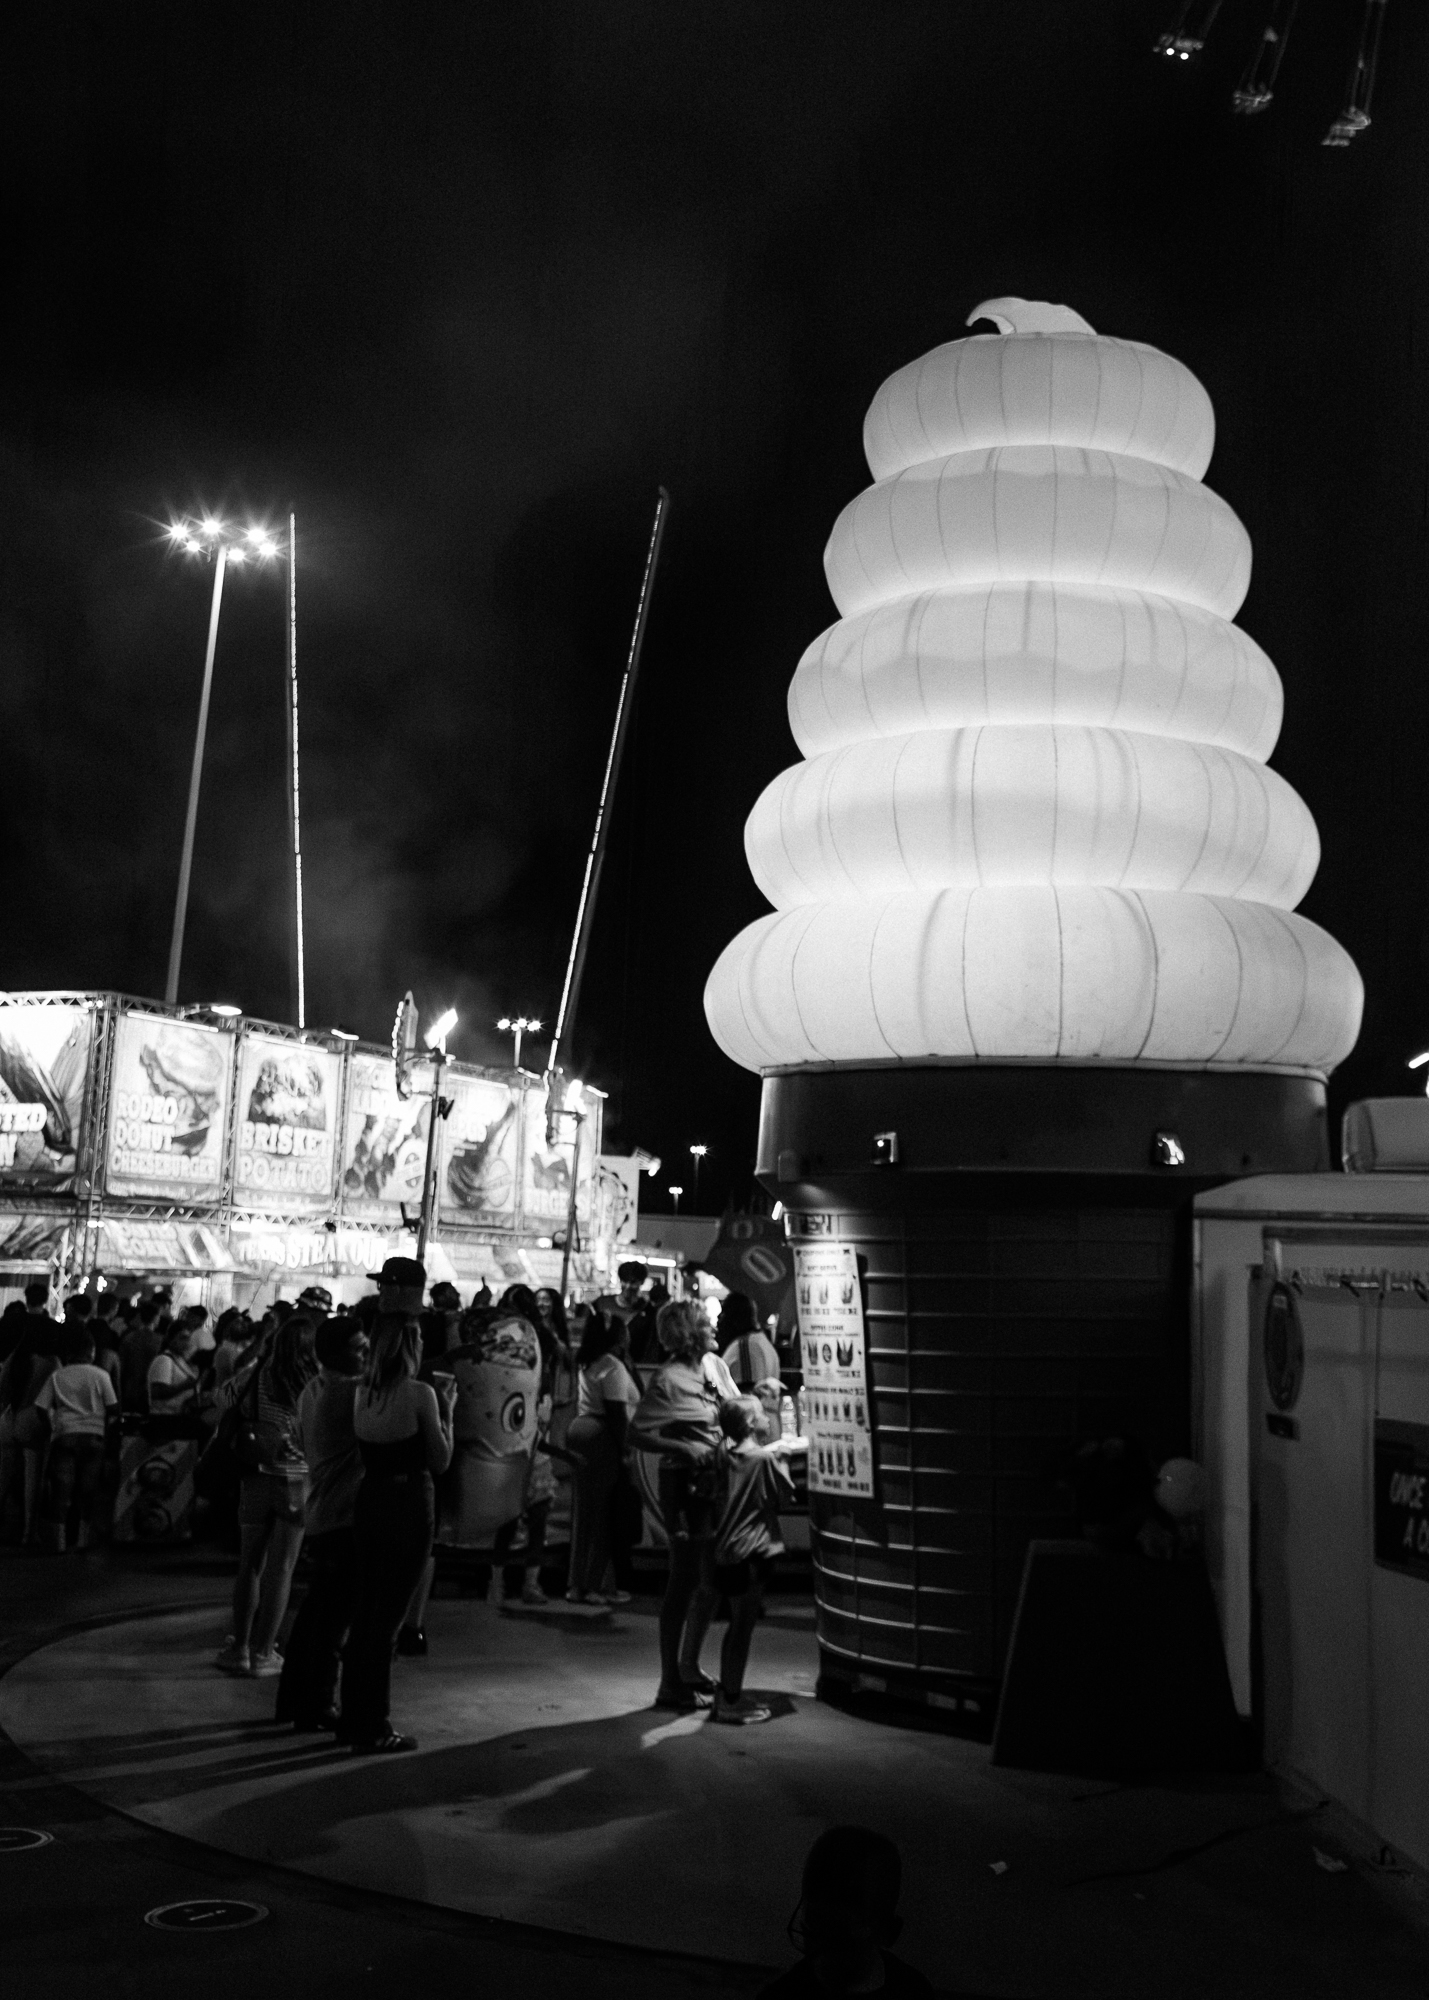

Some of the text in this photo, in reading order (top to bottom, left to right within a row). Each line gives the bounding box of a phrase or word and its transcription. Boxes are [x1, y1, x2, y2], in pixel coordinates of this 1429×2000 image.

[0, 1102, 48, 1132] TED
[115, 1091, 178, 1126] RODEO
[115, 1119, 176, 1152] DONUT
[240, 1120, 331, 1159] BRISKET
[239, 1153, 329, 1192] POTATO
